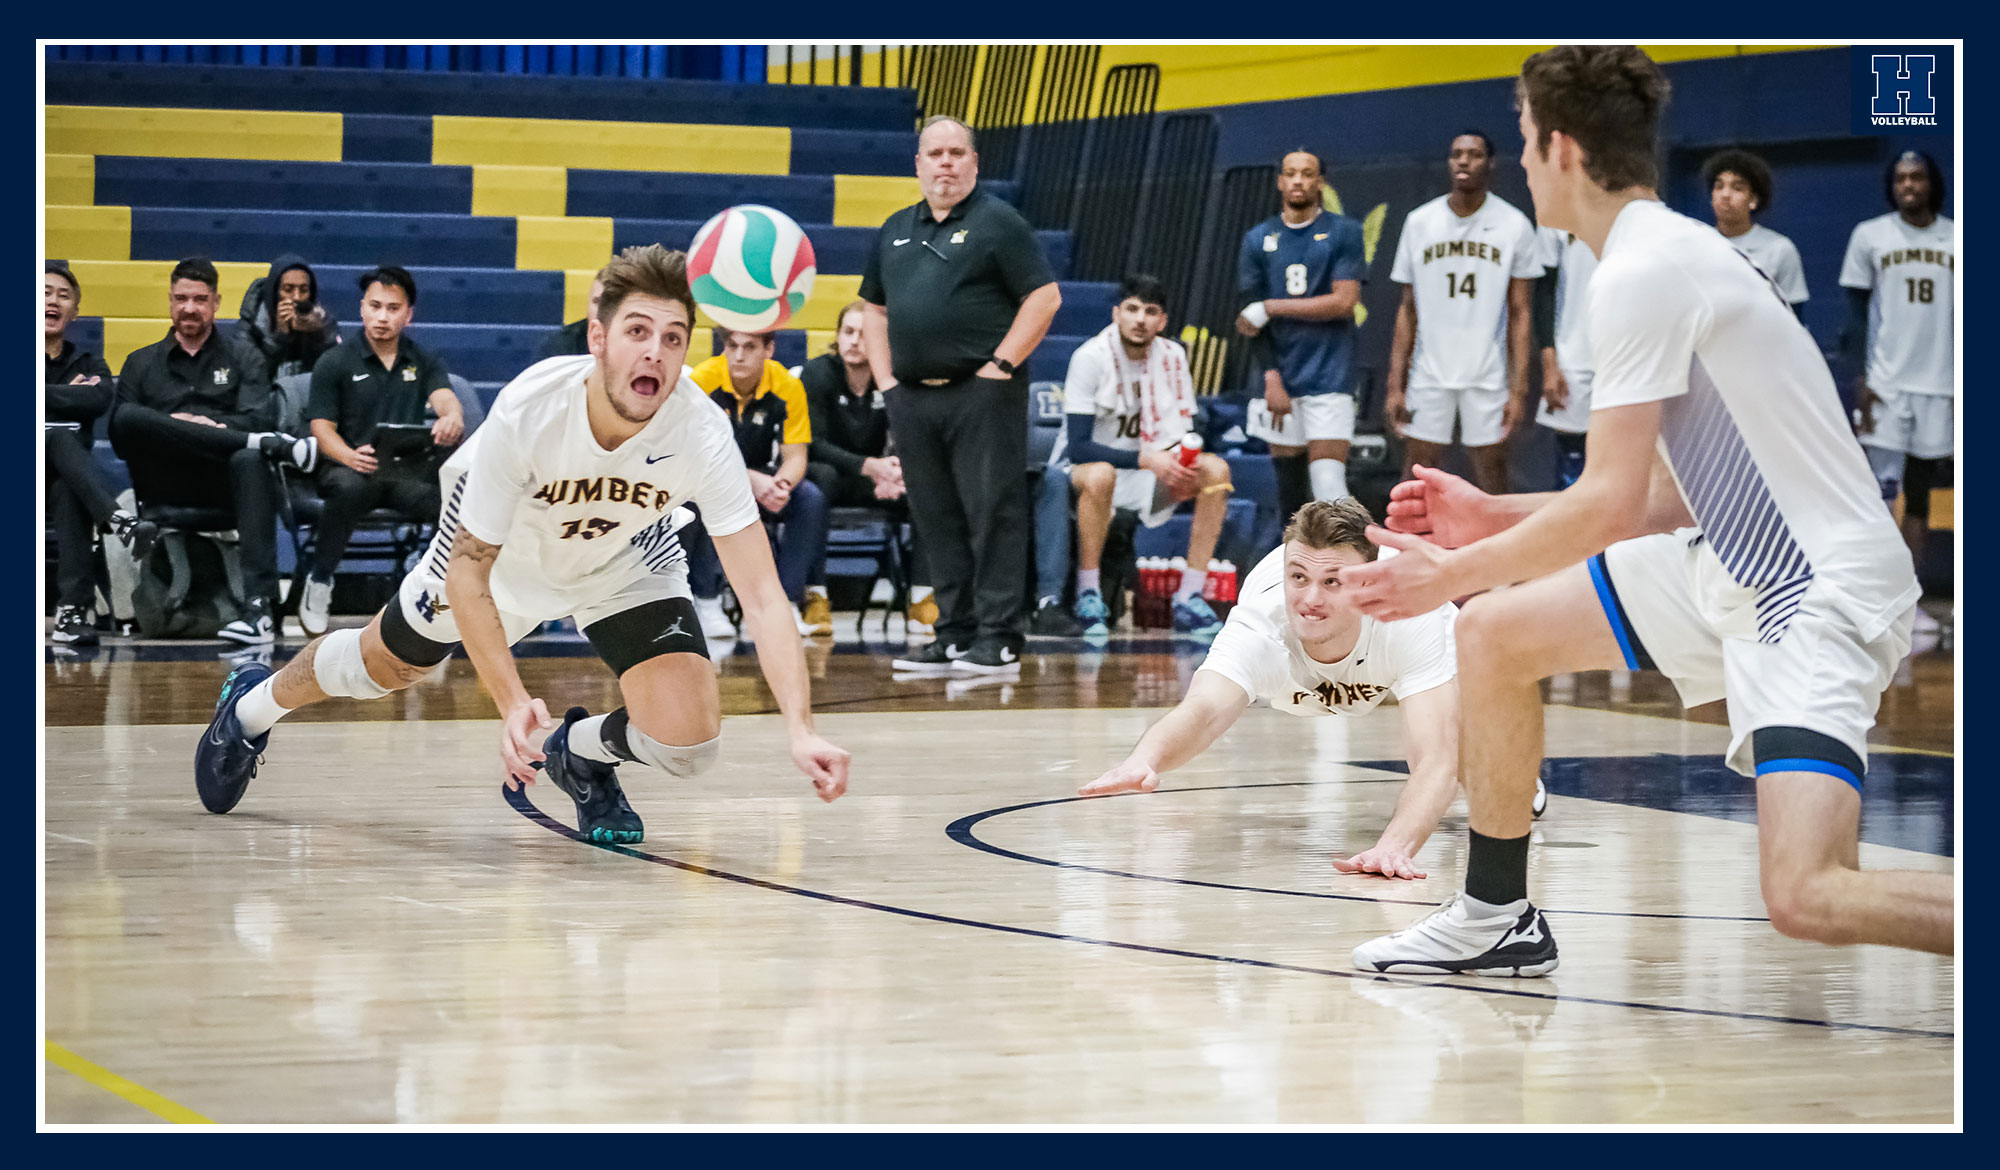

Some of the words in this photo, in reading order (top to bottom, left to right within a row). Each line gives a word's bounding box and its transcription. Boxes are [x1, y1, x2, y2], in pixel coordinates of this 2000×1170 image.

[1423, 240, 1502, 267] HUMBER
[1285, 263, 1308, 296] 8
[1445, 272, 1476, 299] 14
[1905, 277, 1934, 304] 18
[1116, 414, 1141, 439] 10
